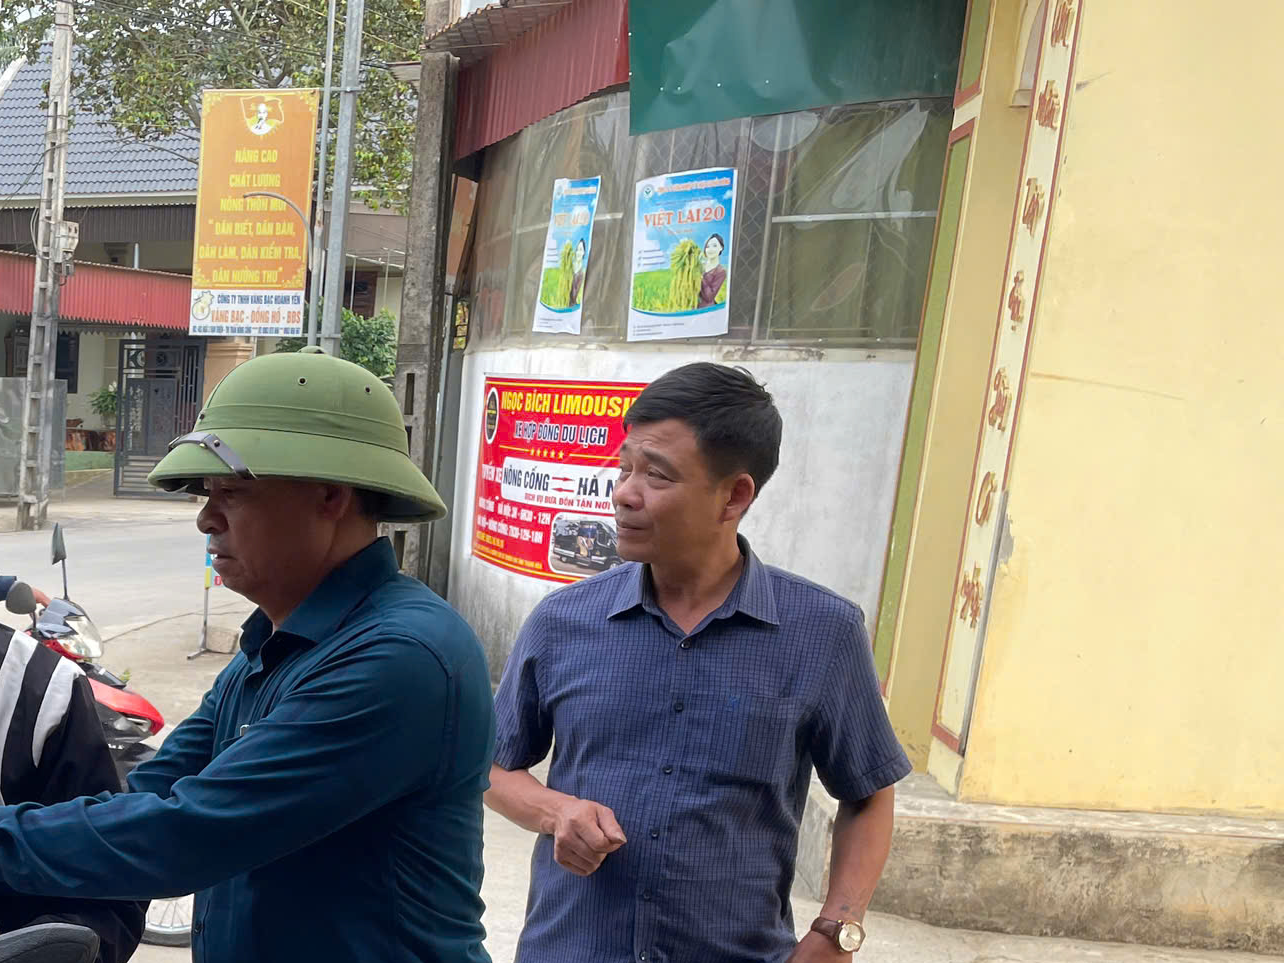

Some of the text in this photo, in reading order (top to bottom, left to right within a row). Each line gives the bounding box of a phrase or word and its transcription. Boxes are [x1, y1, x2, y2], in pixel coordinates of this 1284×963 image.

[501, 391, 524, 415] NGỌC
[524, 389, 551, 413] BÍCH
[561, 424, 576, 443] DU
[579, 426, 608, 448] LỊCH
[503, 465, 522, 487] NÔNG
[523, 466, 550, 492] CỐNG
[577, 475, 599, 496] HÀ
[538, 512, 552, 525] 12H
